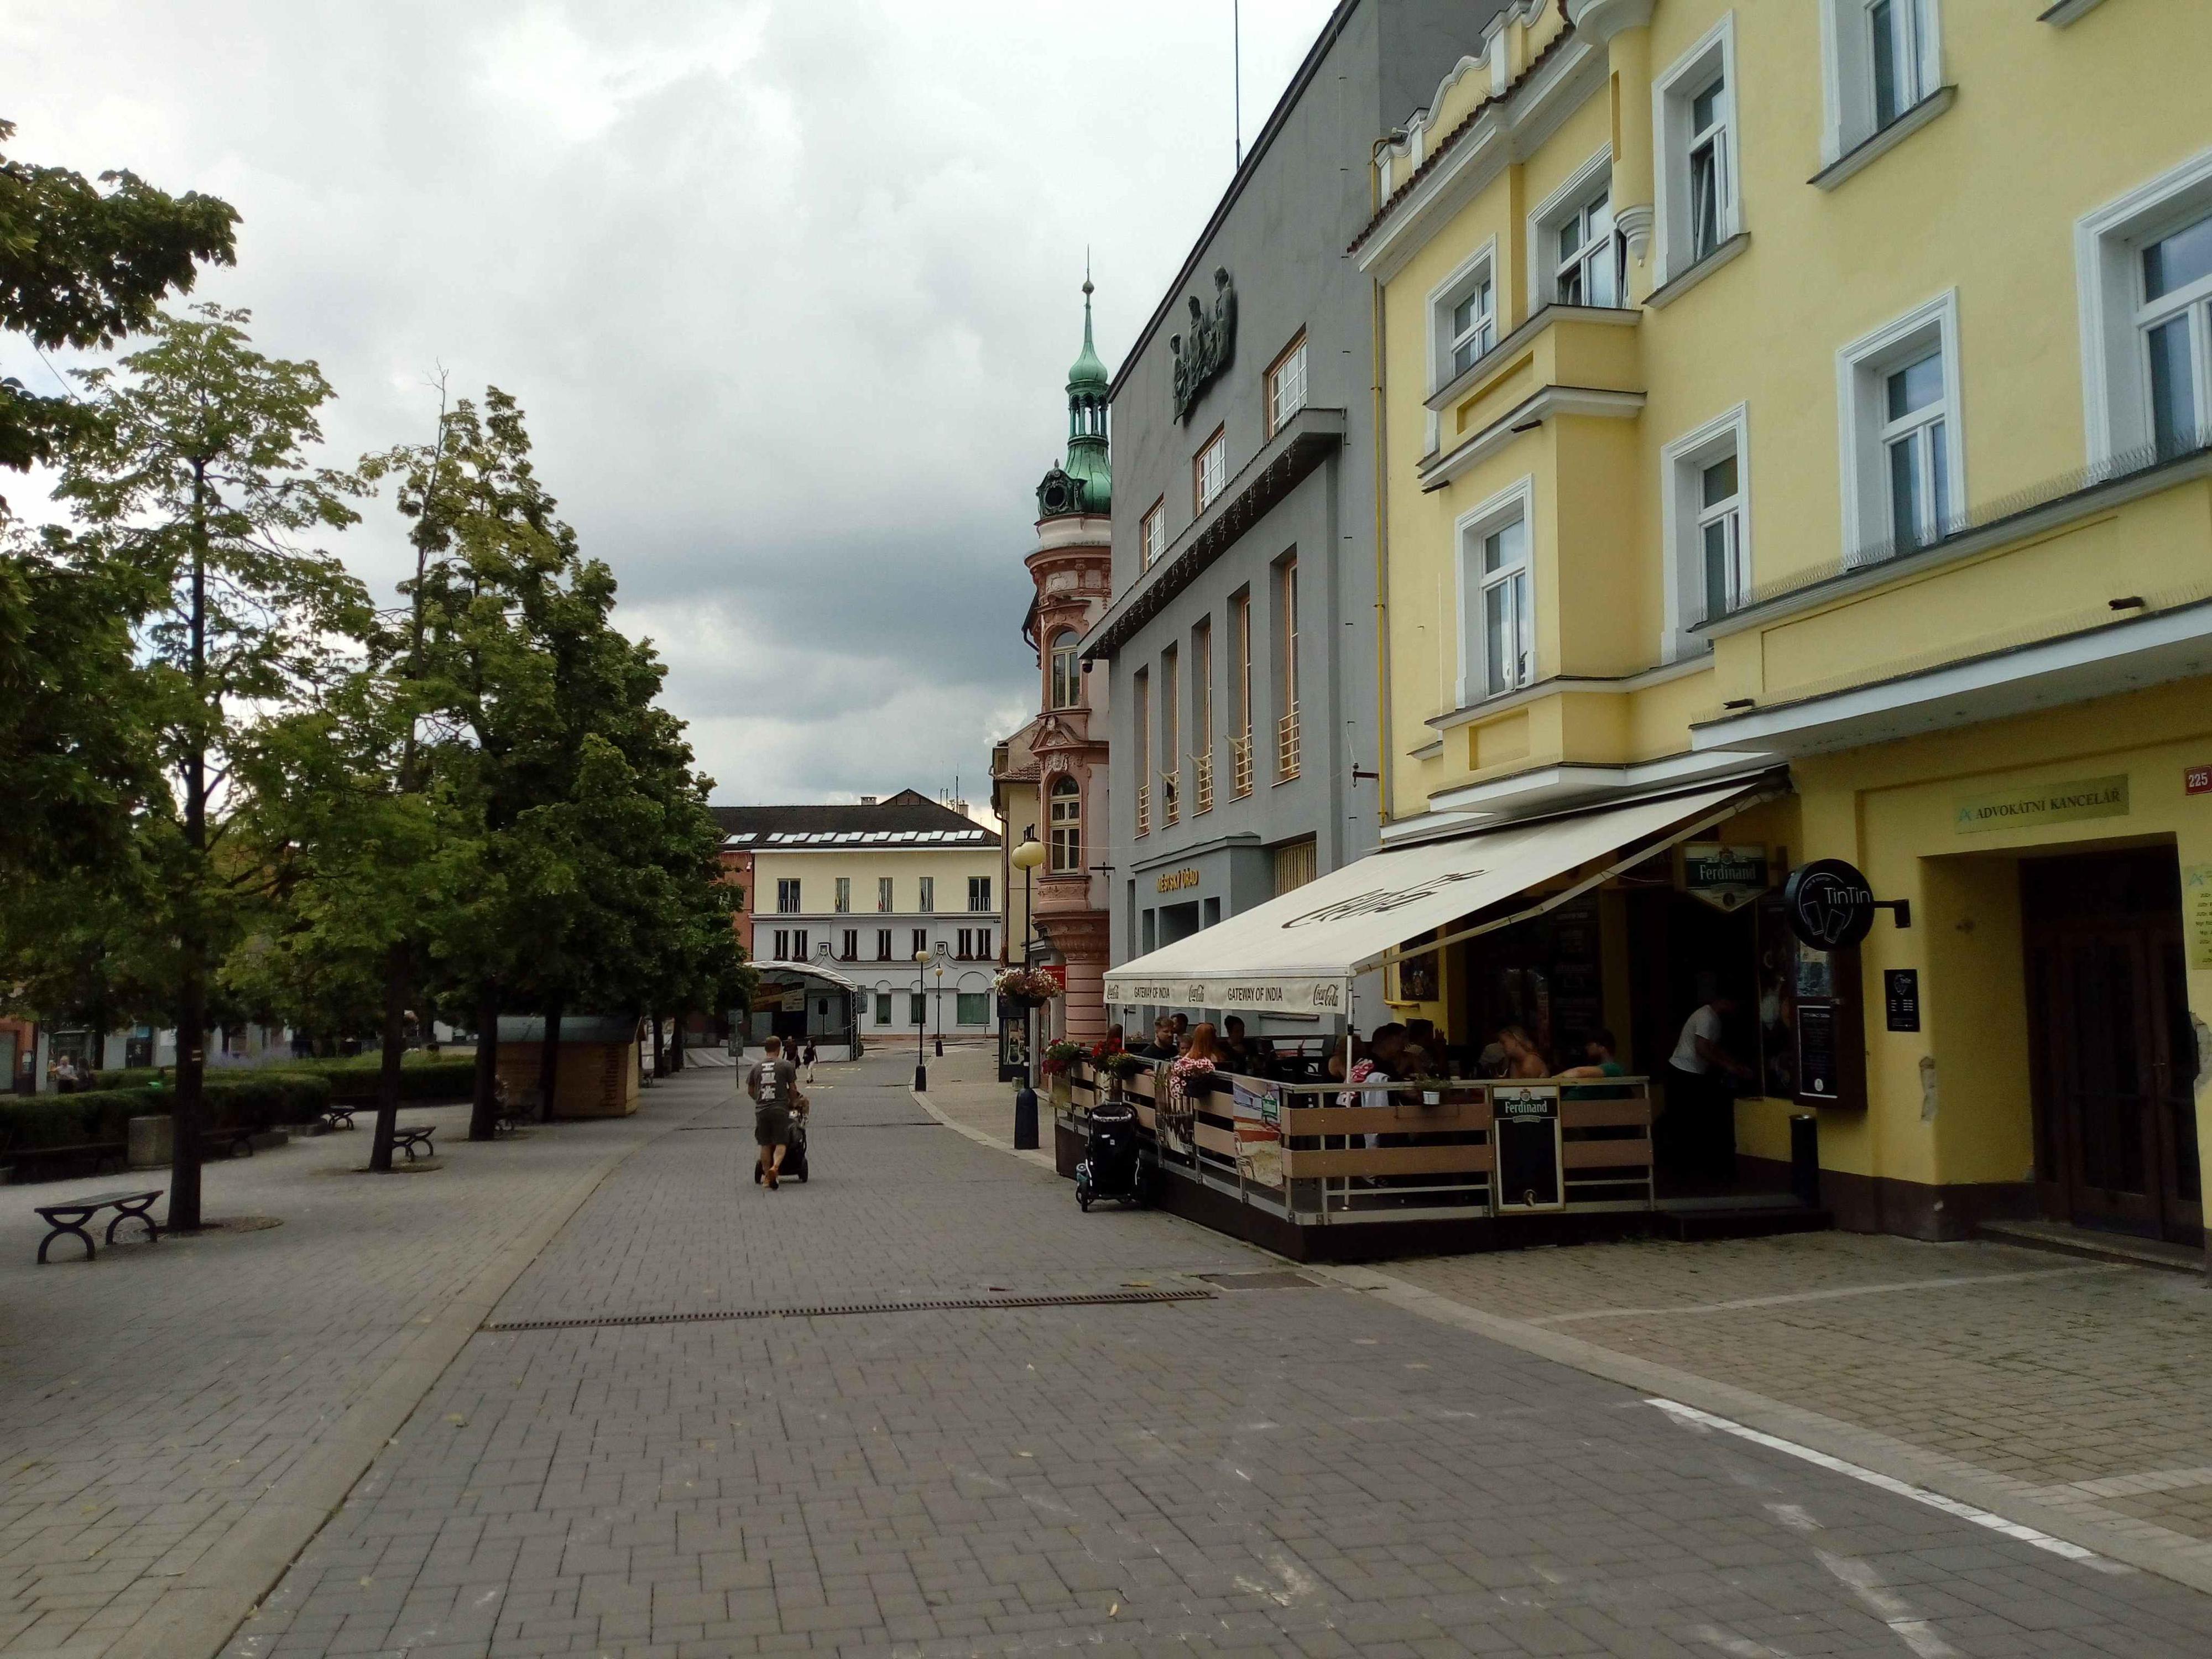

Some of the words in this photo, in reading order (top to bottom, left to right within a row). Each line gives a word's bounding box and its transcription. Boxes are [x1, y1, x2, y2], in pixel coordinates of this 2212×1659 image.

[2188, 771, 2208, 788] 225
[1699, 862, 1757, 881] Ferdinand
[1823, 885, 1871, 905] TinTin
[1134, 986, 1152, 998] GATEWAY
[1152, 987, 1159, 999] OF
[1227, 987, 1255, 1001] GATEWAY
[1255, 987, 1265, 1001] OF
[1265, 987, 1283, 1001] INDIA
[1504, 1100, 1548, 1114] Ferdinand
